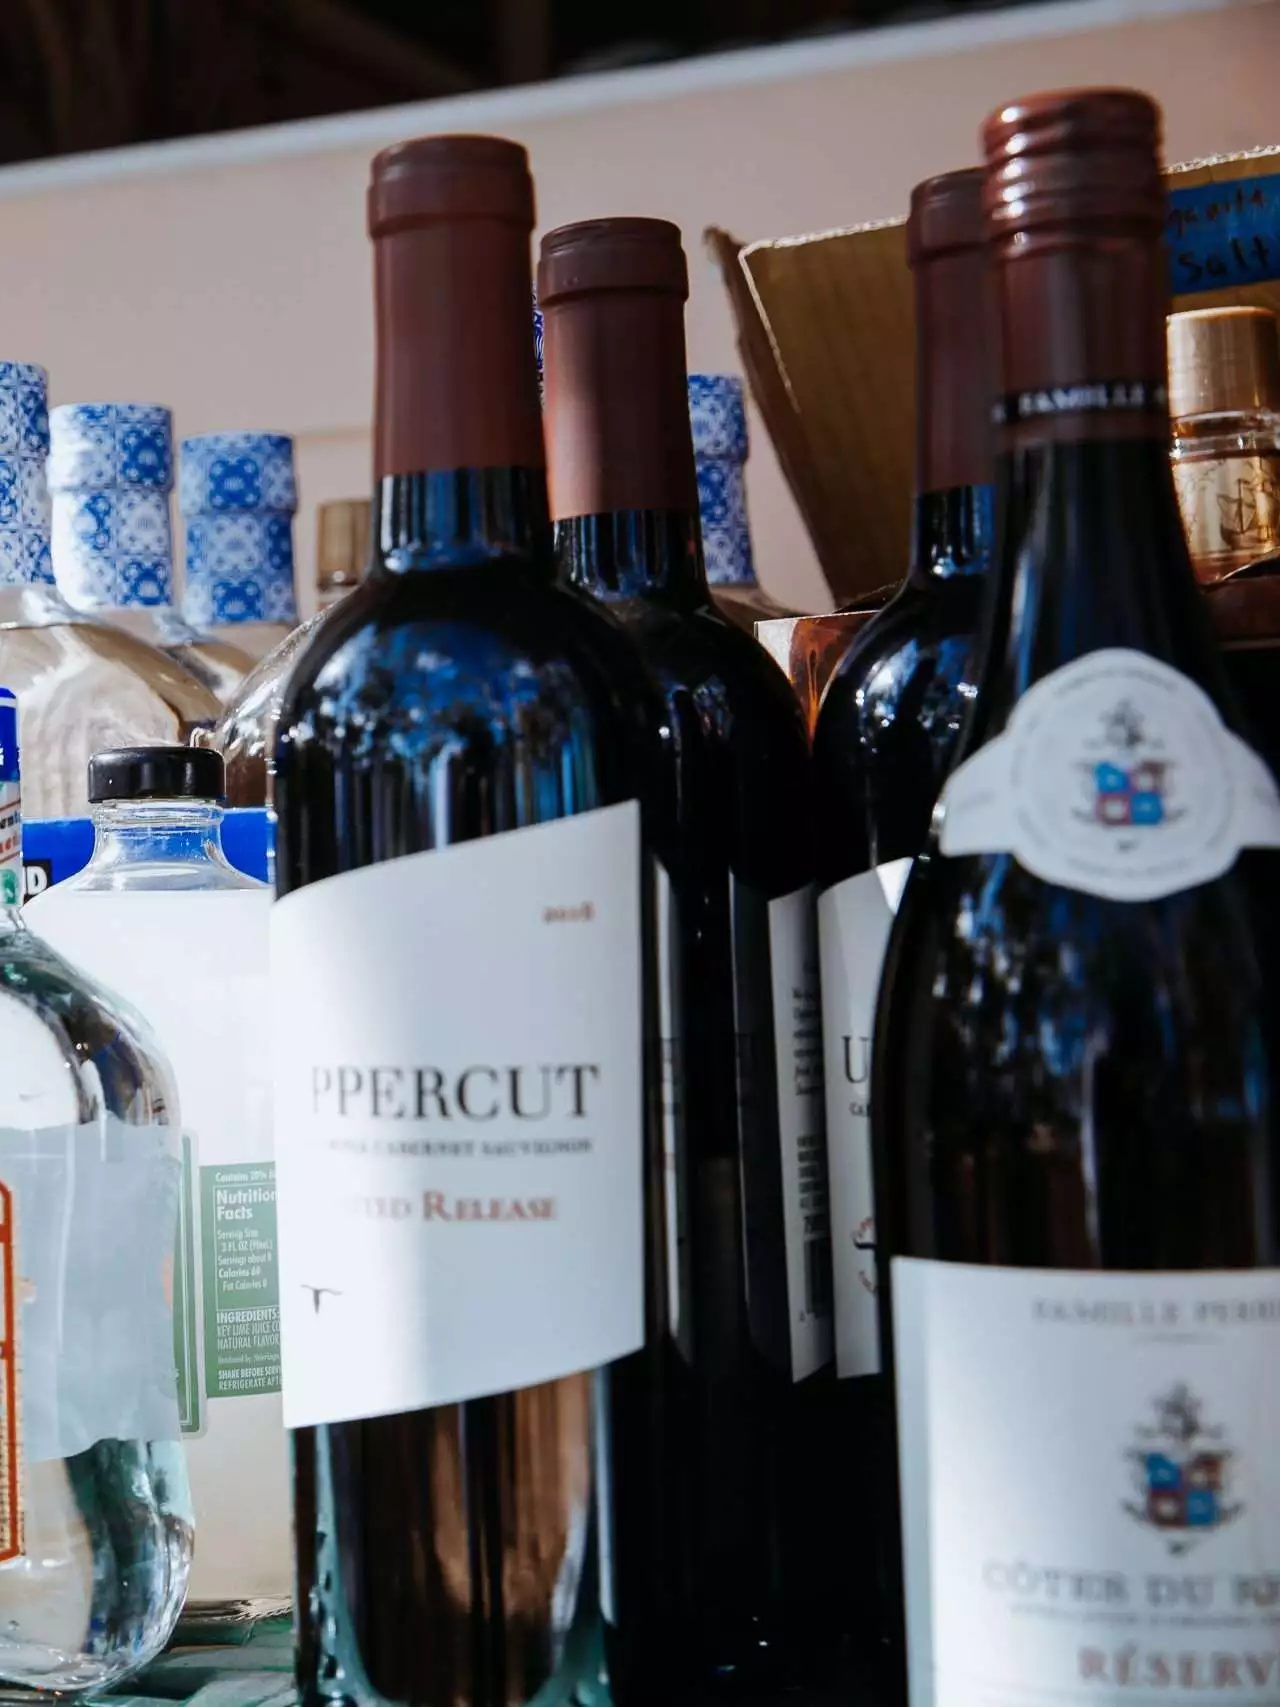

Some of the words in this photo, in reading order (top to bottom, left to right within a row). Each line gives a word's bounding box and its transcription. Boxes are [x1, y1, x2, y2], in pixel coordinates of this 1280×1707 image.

[217, 1187, 280, 1205] Nutrition
[217, 1205, 253, 1220] Facts
[422, 1189, 556, 1222] RELEASE
[219, 1267, 250, 1279] Calories
[217, 1335, 252, 1350] NATURAL
[218, 1369, 240, 1380] SHAKE
[240, 1367, 265, 1378] BEFORE
[218, 1377, 266, 1391] REFRIGERATE
